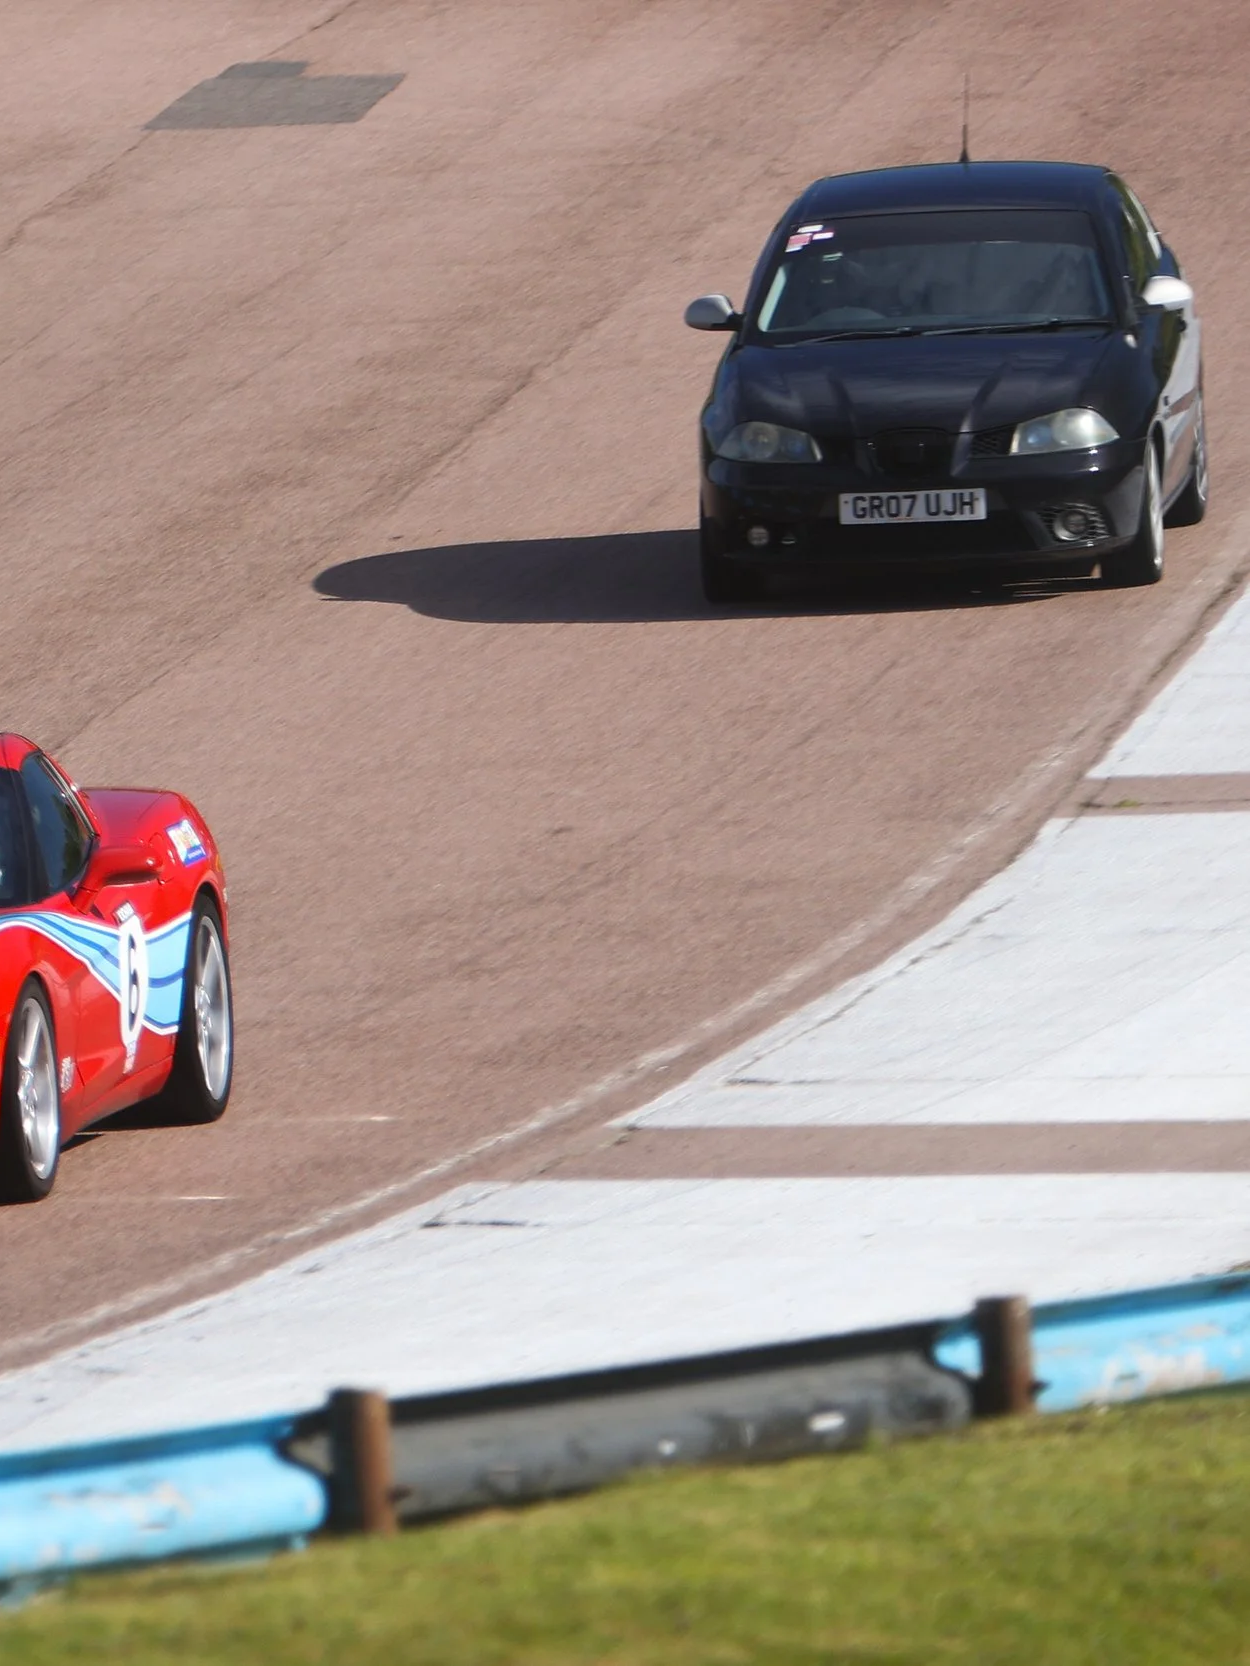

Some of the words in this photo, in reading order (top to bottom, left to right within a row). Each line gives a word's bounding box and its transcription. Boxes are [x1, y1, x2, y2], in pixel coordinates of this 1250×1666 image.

[852, 494, 917, 519] GR07
[924, 491, 975, 517] UJH
[128, 933, 140, 1032] 6
